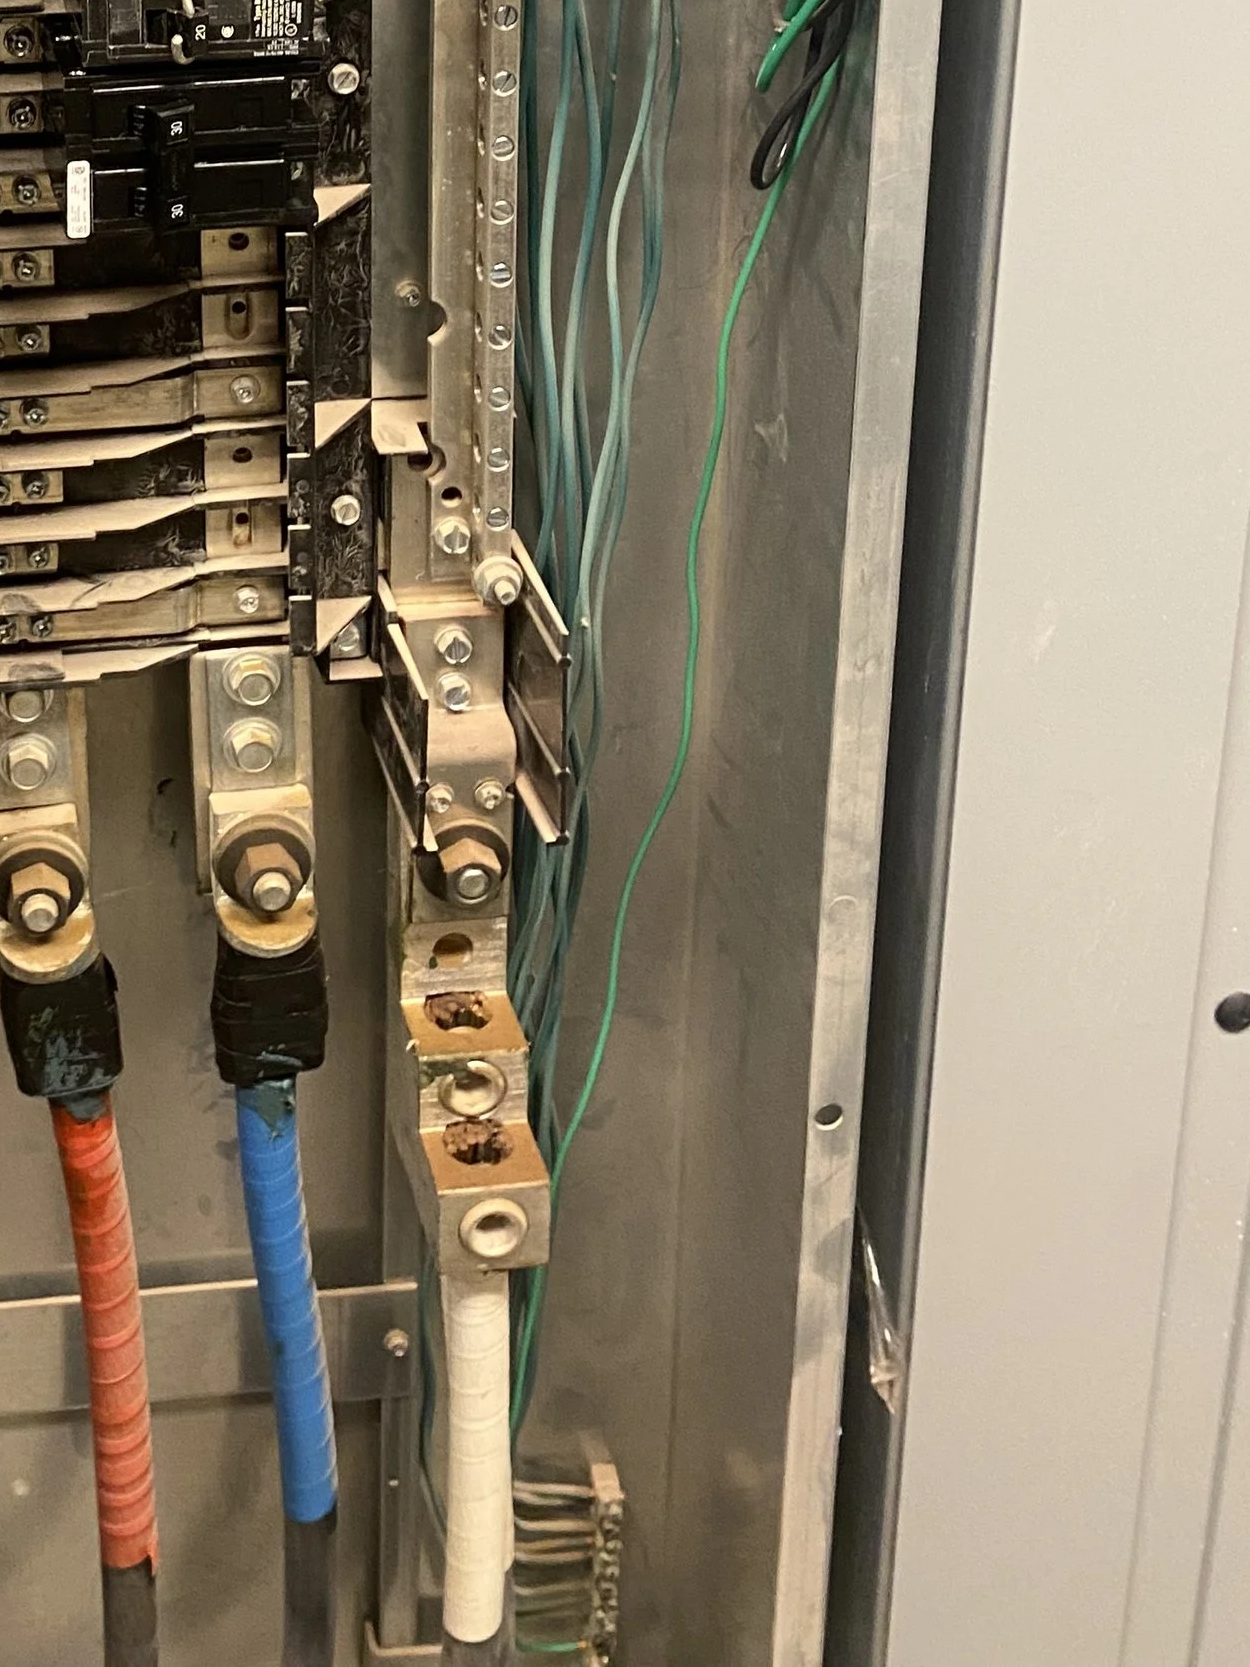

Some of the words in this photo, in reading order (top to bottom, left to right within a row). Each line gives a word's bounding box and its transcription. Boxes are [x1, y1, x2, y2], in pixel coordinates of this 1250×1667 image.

[195, 25, 207, 41] 20
[171, 121, 183, 136] 30
[171, 204, 184, 219] 30
